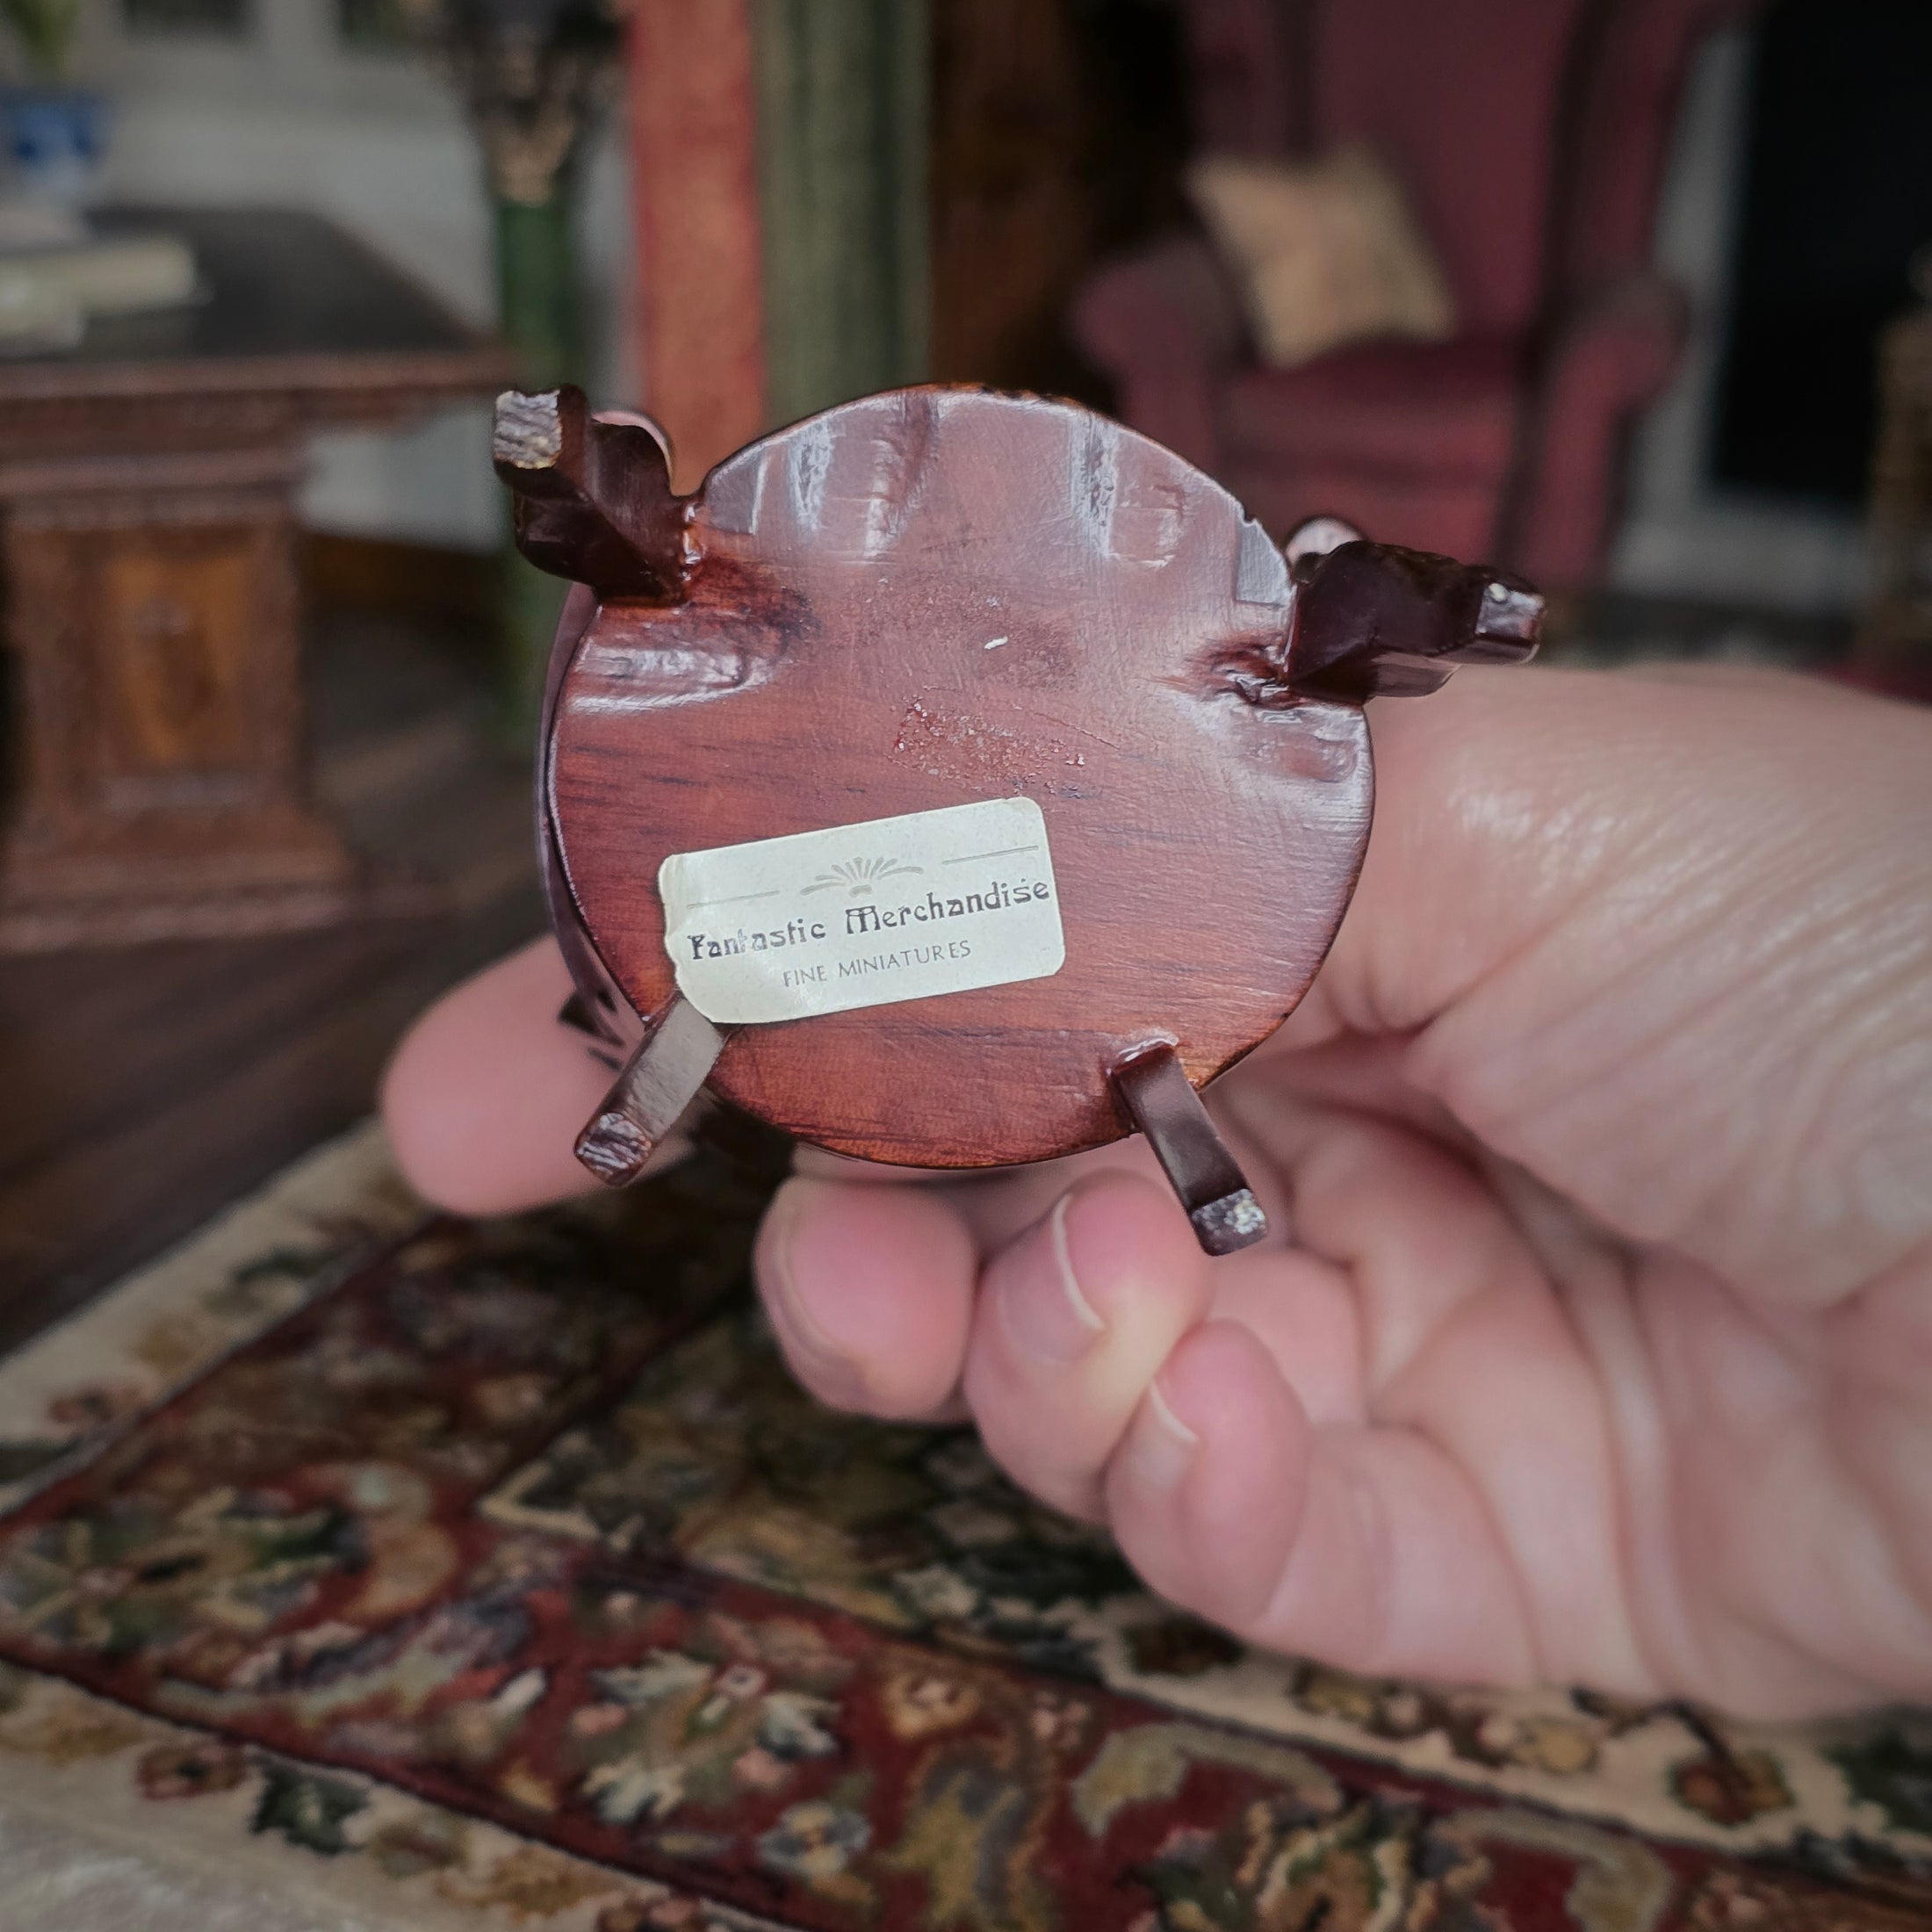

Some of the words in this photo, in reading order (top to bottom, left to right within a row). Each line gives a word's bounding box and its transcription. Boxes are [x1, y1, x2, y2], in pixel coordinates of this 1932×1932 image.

[687, 918, 826, 961] Fantastic
[846, 878, 1050, 935] Merchandise
[782, 965, 827, 988] FINE
[839, 940, 971, 978] MINIATURES
